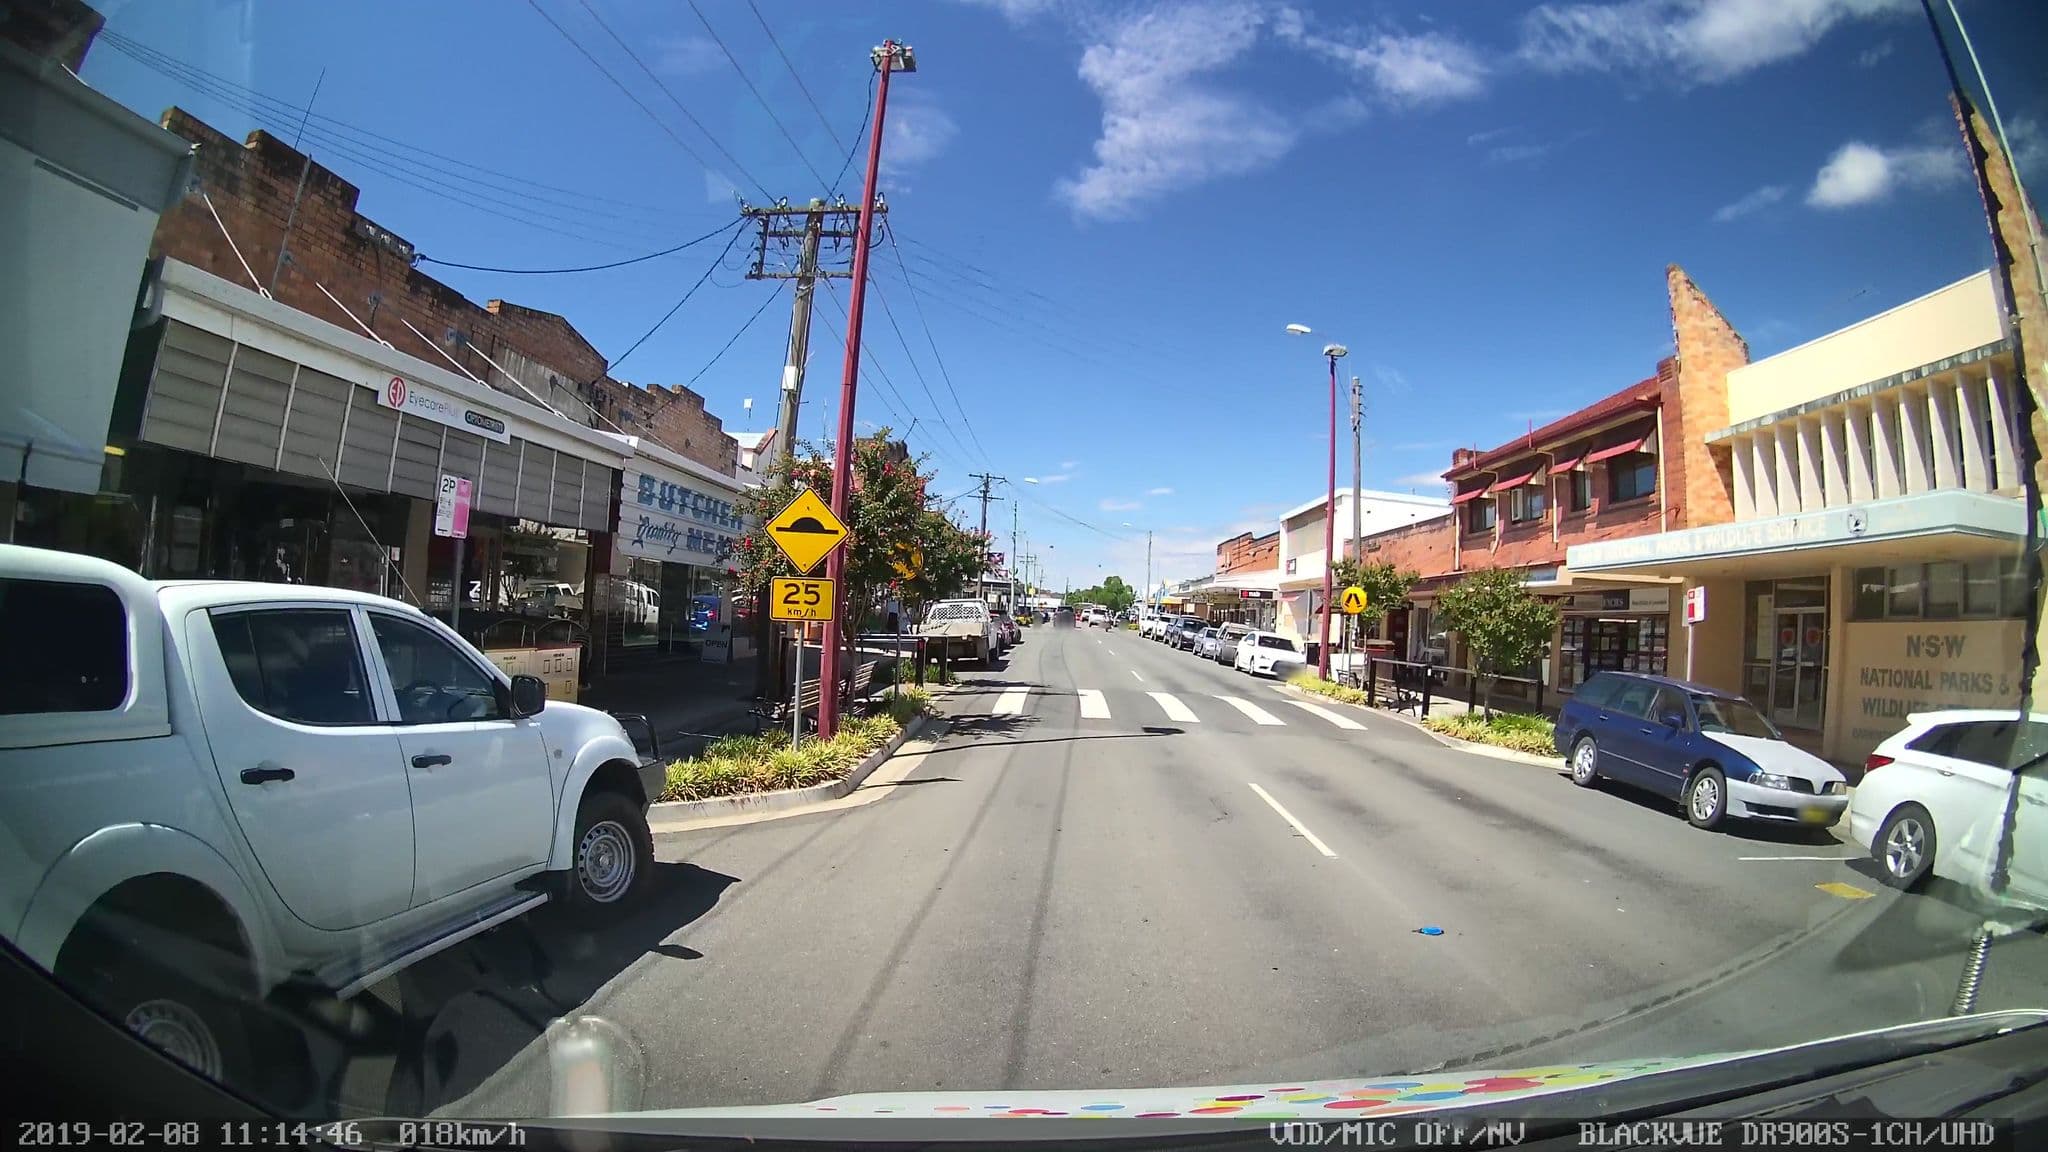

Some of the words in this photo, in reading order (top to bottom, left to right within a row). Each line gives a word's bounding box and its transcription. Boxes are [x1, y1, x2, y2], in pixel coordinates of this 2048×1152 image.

[408, 390, 461, 419] EyecarePlu
[441, 477, 456, 493] 2P
[783, 583, 820, 606] 25
[788, 608, 816, 617] km/h
[1860, 666, 1933, 690] NATIONAL
[1939, 671, 1993, 694] PARKS
[1998, 677, 2010, 696] &
